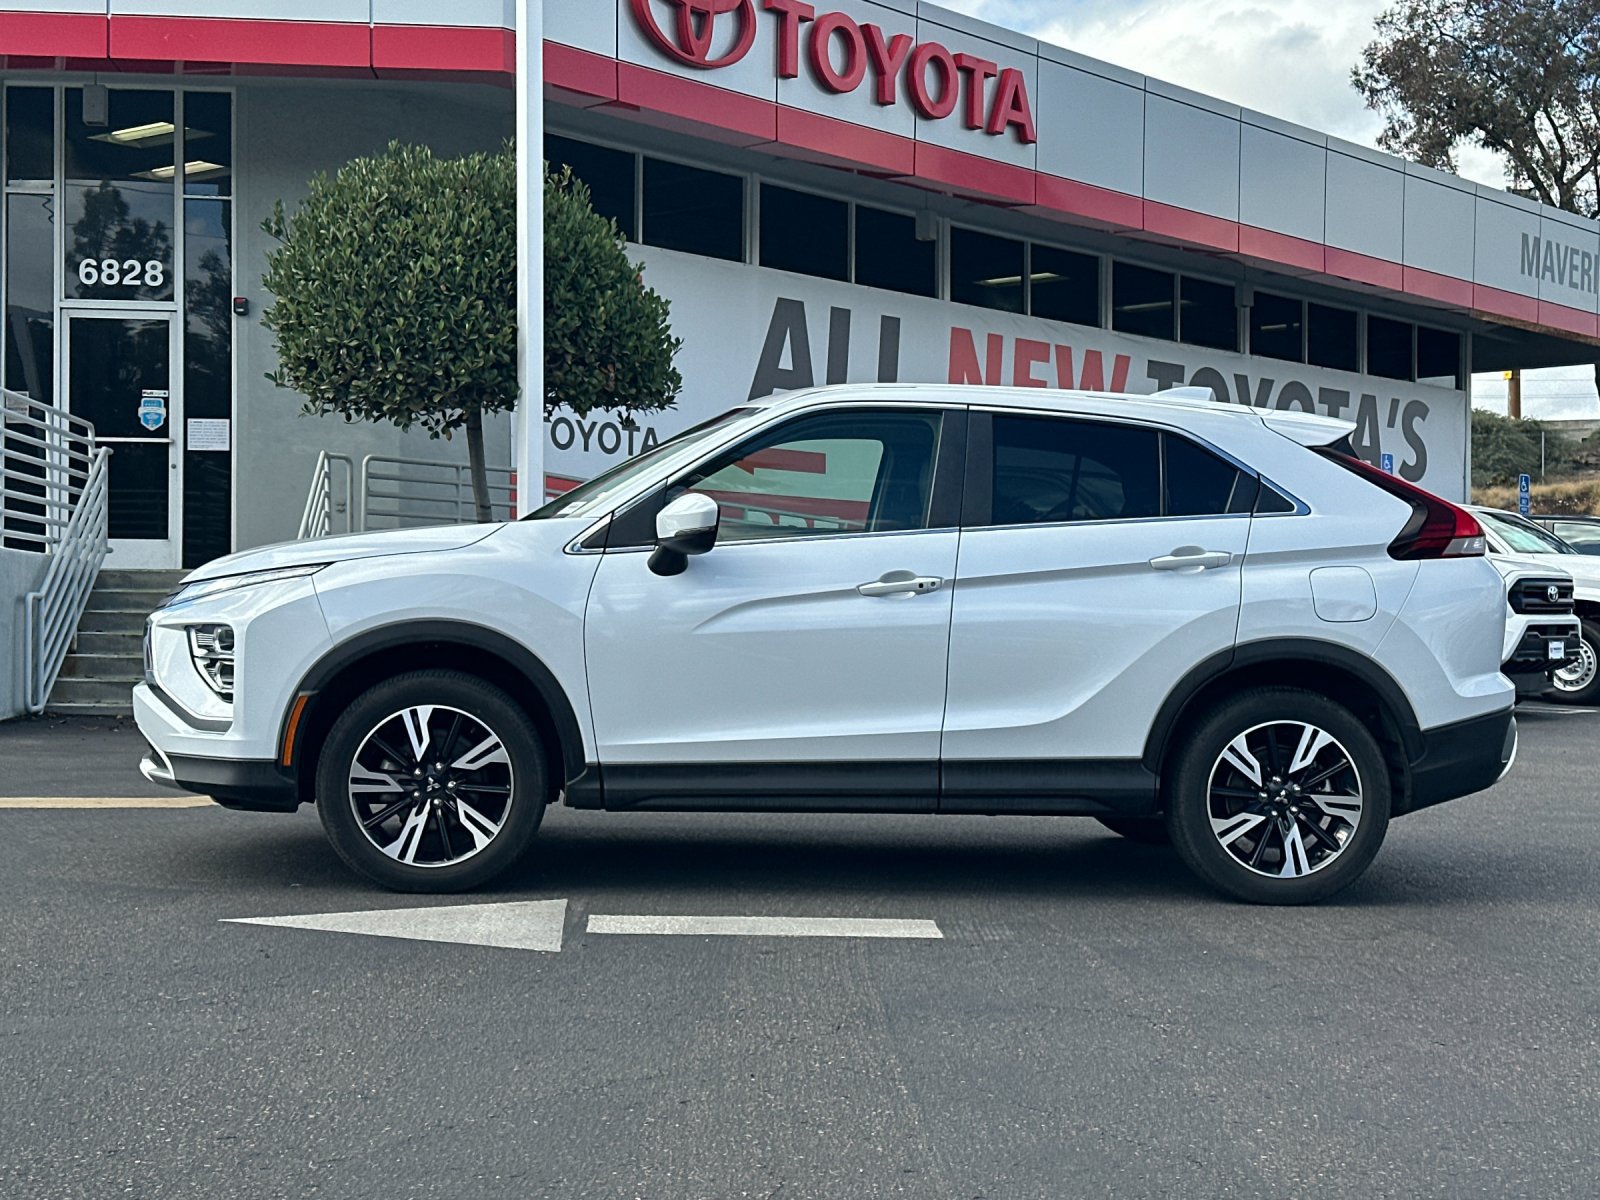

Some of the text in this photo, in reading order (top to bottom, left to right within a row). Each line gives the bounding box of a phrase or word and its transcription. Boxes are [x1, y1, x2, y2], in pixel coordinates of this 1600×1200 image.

[764, 0, 1037, 144] TOYOTA
[78, 258, 164, 287] 6828
[1520, 232, 1600, 294] MAVERI
[543, 415, 660, 456] OYOTA
